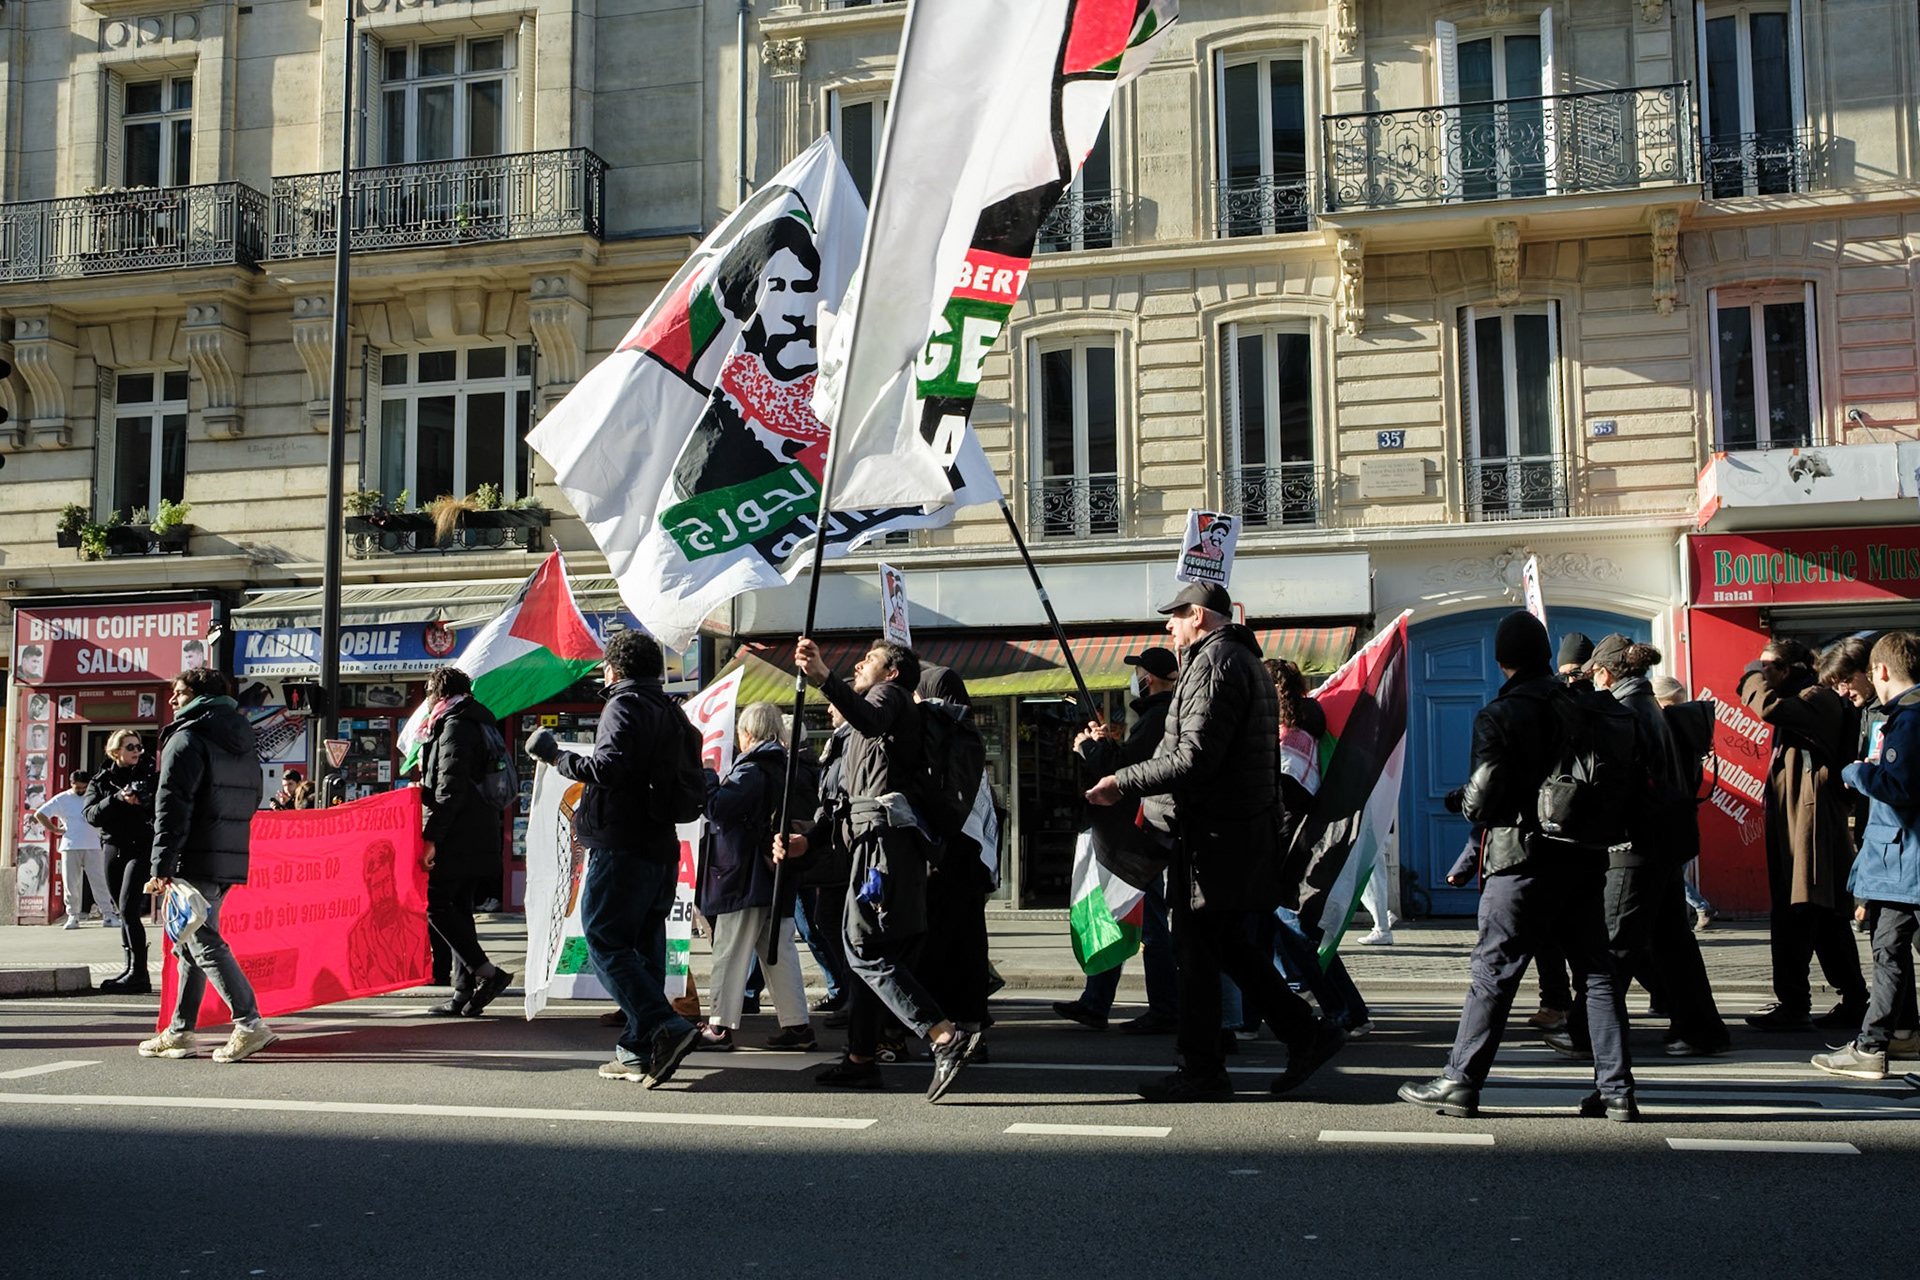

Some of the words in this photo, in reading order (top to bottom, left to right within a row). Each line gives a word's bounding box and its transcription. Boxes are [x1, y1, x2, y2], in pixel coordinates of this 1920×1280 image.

[1381, 432, 1401, 448] 35
[1185, 556, 1220, 569] GEORGES
[1714, 545, 1857, 586] Boucherie
[1714, 590, 1753, 602] Halal
[30, 616, 89, 642] BISMI
[96, 613, 199, 640] COIFFURE
[245, 633, 314, 658] KABUL
[319, 630, 401, 656] OBILE
[77, 647, 149, 674] SALON
[373, 662, 397, 671] Carte
